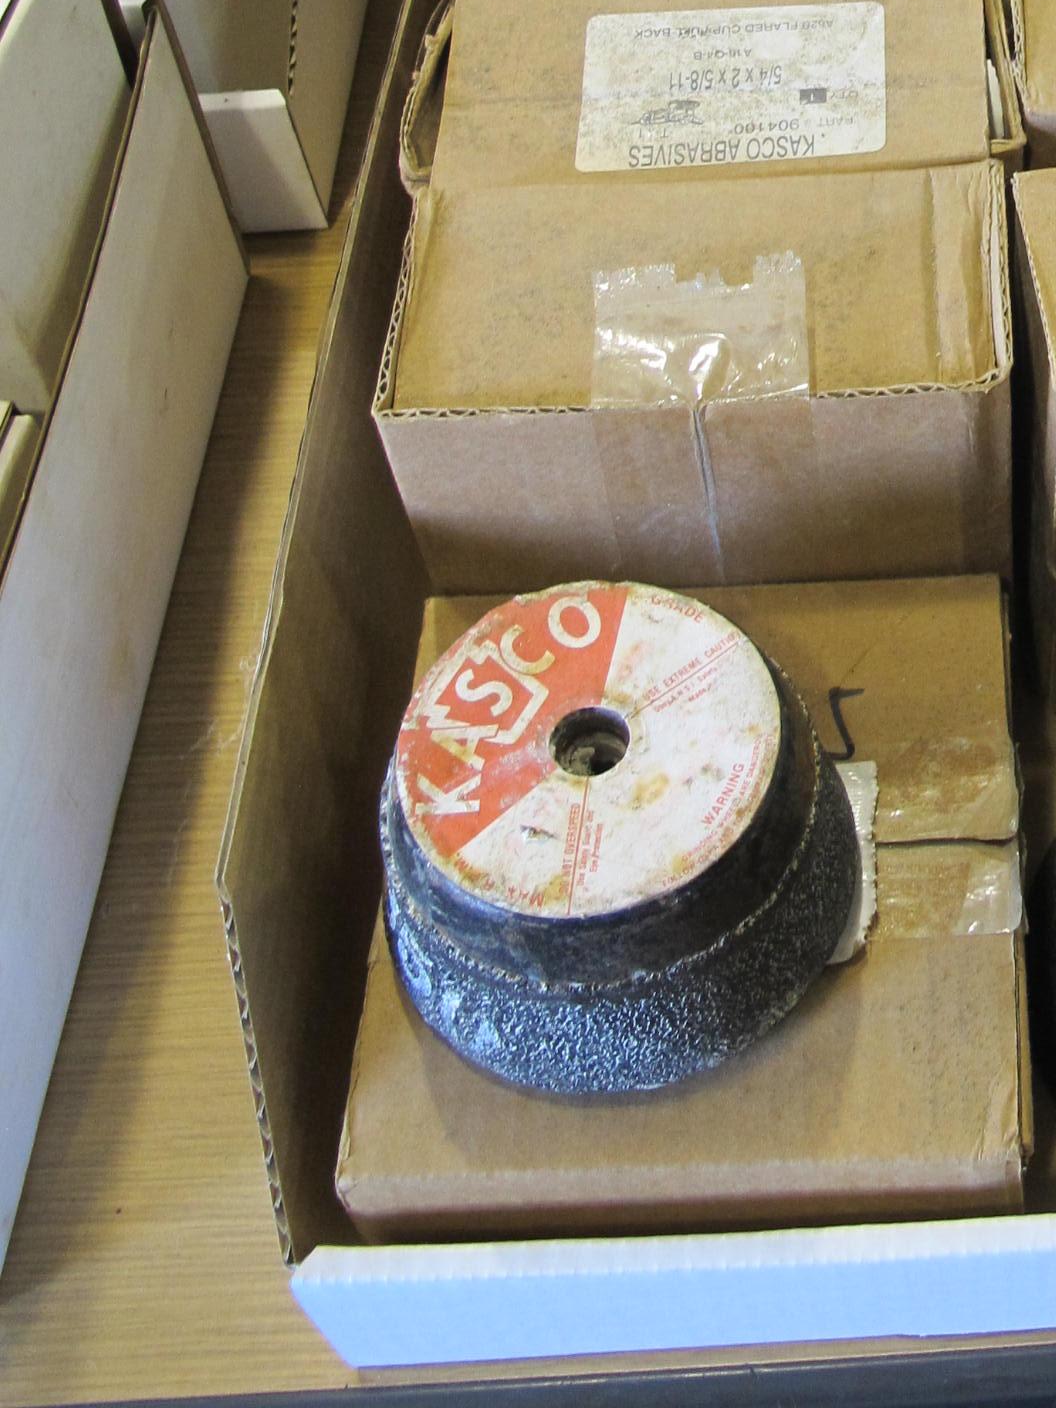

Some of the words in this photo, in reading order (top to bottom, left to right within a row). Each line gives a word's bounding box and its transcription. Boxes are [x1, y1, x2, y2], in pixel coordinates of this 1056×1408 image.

[668, 69, 714, 90] 5/8-11
[731, 68, 740, 87] 2
[759, 64, 783, 86] 5/4
[628, 139, 740, 168] ABRASIVES
[747, 134, 815, 161] KASCO
[415, 596, 601, 816] KASCO
[702, 763, 745, 826] WARNING
